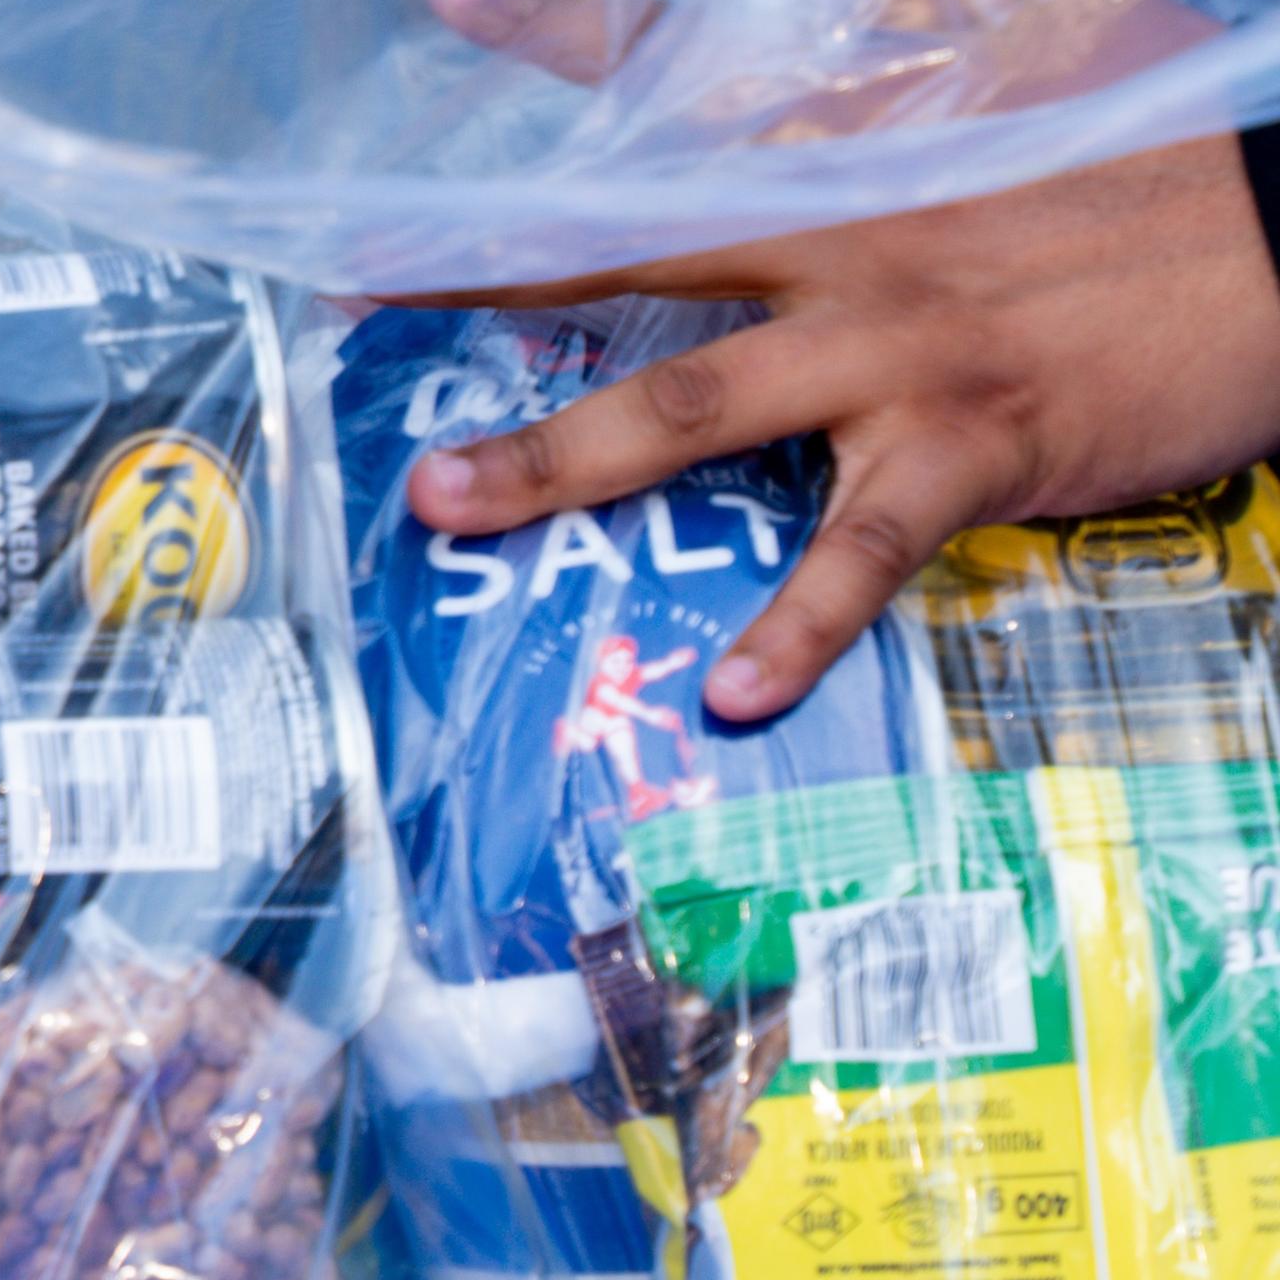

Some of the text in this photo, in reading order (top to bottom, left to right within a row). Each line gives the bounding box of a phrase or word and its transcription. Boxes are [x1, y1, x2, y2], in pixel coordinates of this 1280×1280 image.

[4, 460, 38, 575] BAKED
[427, 488, 795, 617] SALT
[987, 1186, 1070, 1220] 400 g
